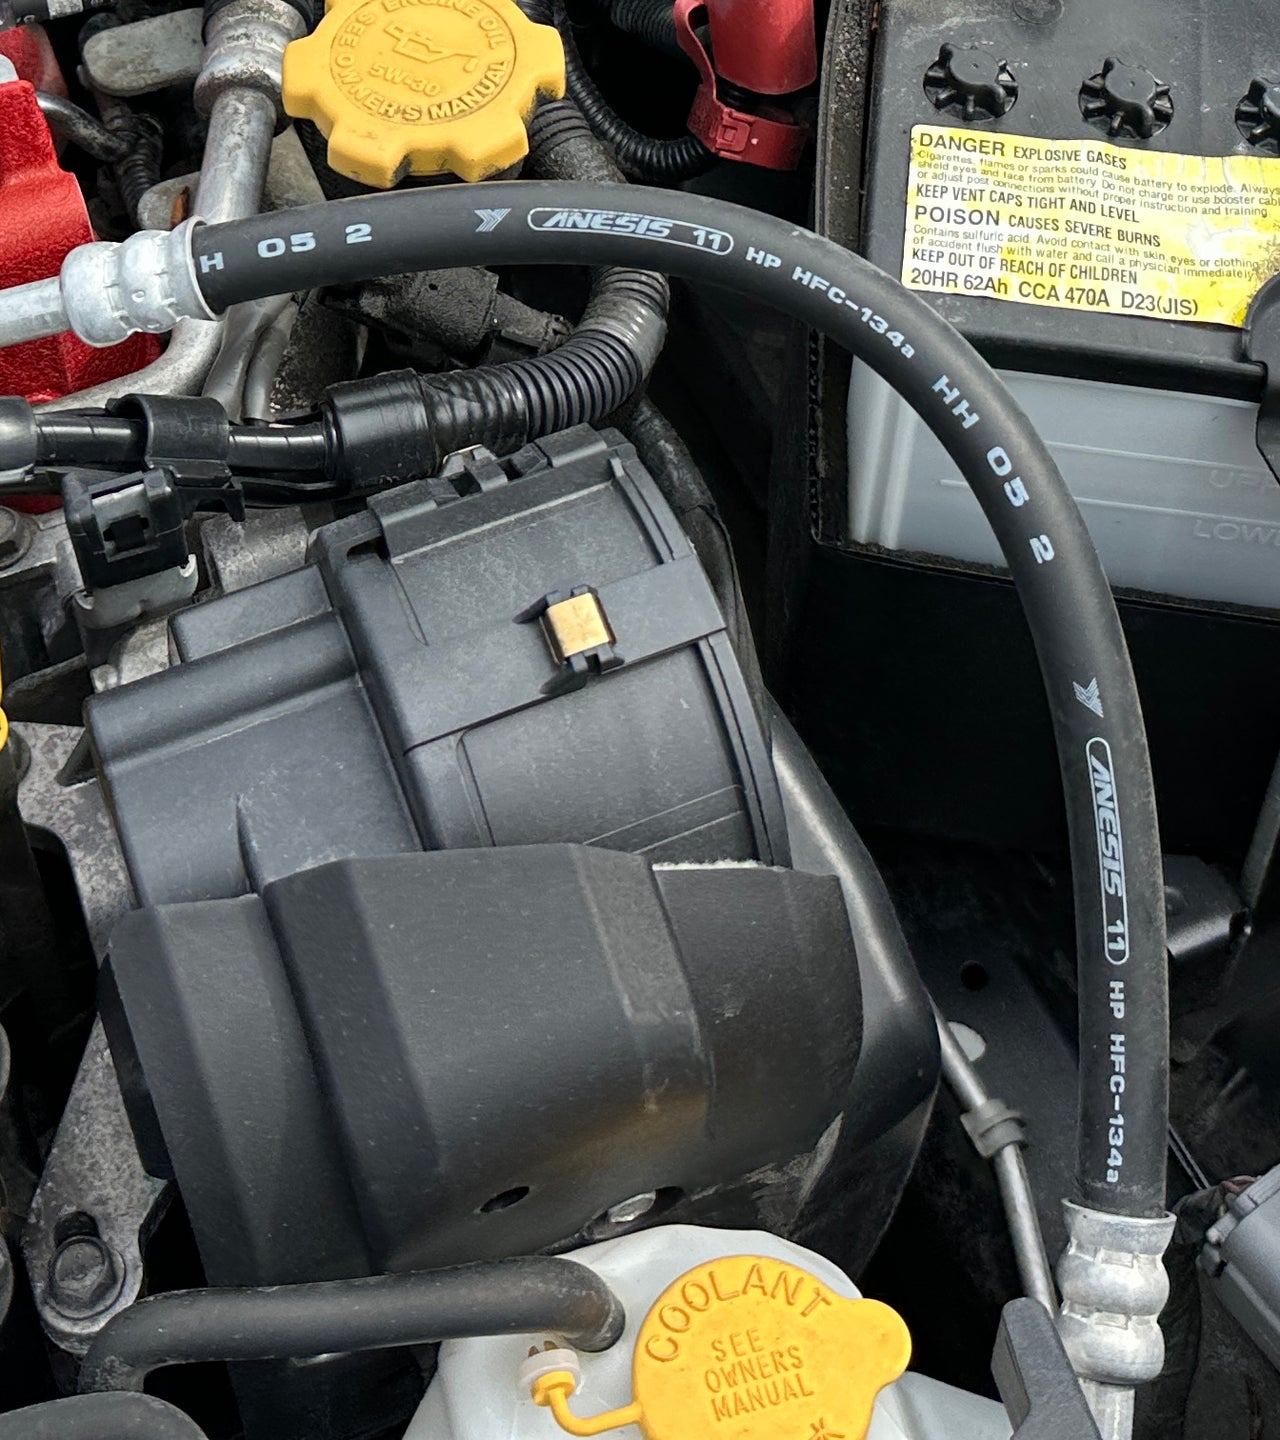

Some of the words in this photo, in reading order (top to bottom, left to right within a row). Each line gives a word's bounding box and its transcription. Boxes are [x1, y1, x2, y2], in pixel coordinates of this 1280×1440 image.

[478, 16, 509, 50] OIL
[340, 11, 376, 48] SEE
[428, 59, 511, 121] MANUAL
[369, 63, 442, 97] 5W-30
[920, 133, 1005, 156] DANGER
[1014, 146, 1081, 162] EXPLOSIVE
[1086, 150, 1127, 170] GASES
[917, 170, 927, 178] or
[932, 171, 963, 183] adjust
[967, 177, 989, 186] post
[993, 179, 1055, 193] connections
[1059, 185, 1099, 198] without
[1103, 191, 1135, 205] proper
[1140, 198, 1197, 214] instruction
[1202, 205, 1220, 215] and
[918, 160, 948, 171] shield
[953, 165, 977, 174] eyes
[981, 168, 998, 178] and
[1029, 172, 1054, 183] from
[1102, 180, 1115, 190] Do
[1119, 183, 1135, 194] not
[1139, 190, 1173, 201] charge
[1178, 195, 1189, 203] or
[1192, 195, 1210, 204] use
[1214, 194, 1254, 205] booster
[980, 158, 1015, 171] flames
[1018, 164, 1029, 172] or
[1032, 165, 1067, 174] sparks
[1070, 166, 1098, 176] could
[1102, 168, 1130, 183] cause
[1134, 177, 1173, 192] battery
[1177, 182, 1187, 192] to
[1241, 183, 1280, 195] Always
[916, 183, 948, 199] KEEP
[952, 186, 985, 202] VENT
[989, 189, 1022, 207] CAPS
[1027, 196, 1066, 210] TIGHT
[1070, 198, 1096, 214] AND
[1101, 203, 1140, 223] LEVEL
[914, 205, 1000, 226] POISON
[1008, 214, 1060, 232] CAUSES
[1065, 219, 1112, 240] SEVERE
[1118, 229, 1161, 248] BURNS
[914, 224, 960, 239] Contains
[962, 229, 1004, 242] sulfuric
[1037, 234, 1067, 247] Avoid
[1071, 238, 1110, 252] contact
[1115, 245, 1139, 257] with
[1171, 255, 1196, 267] eyes
[912, 247, 944, 263] KEEP
[948, 252, 975, 268] OUT
[979, 256, 996, 270] OF
[1000, 258, 1044, 275] REACH
[1048, 262, 1066, 278] OF
[1070, 264, 1138, 285] CHILDREN
[913, 236, 925, 246] of
[928, 237, 972, 252] accident
[977, 243, 1003, 254] flush
[1007, 245, 1032, 256] with
[1036, 248, 1068, 259] water
[1073, 250, 1092, 261] and
[1096, 254, 1114, 264] call
[1119, 257, 1125, 266] a
[1129, 258, 1180, 274] physician
[911, 268, 958, 288] 20HR
[964, 273, 1008, 295] 62Ah
[1019, 281, 1060, 302] CCA
[1065, 286, 1110, 308] 470A
[1121, 290, 1198, 316] D23(JIS)
[345, 222, 372, 245] 2
[746, 245, 781, 270] HP
[791, 264, 915, 359] HFC-134a
[932, 374, 980, 429] HH
[1029, 534, 1055, 564] 2
[1109, 981, 1125, 1019] HP
[1106, 1034, 1125, 1183] HFC-134a
[646, 1262, 833, 1364] COOLANT
[710, 1328, 764, 1362] SEE
[704, 1344, 805, 1394] OWNERS
[710, 1372, 815, 1423] MANUAL
